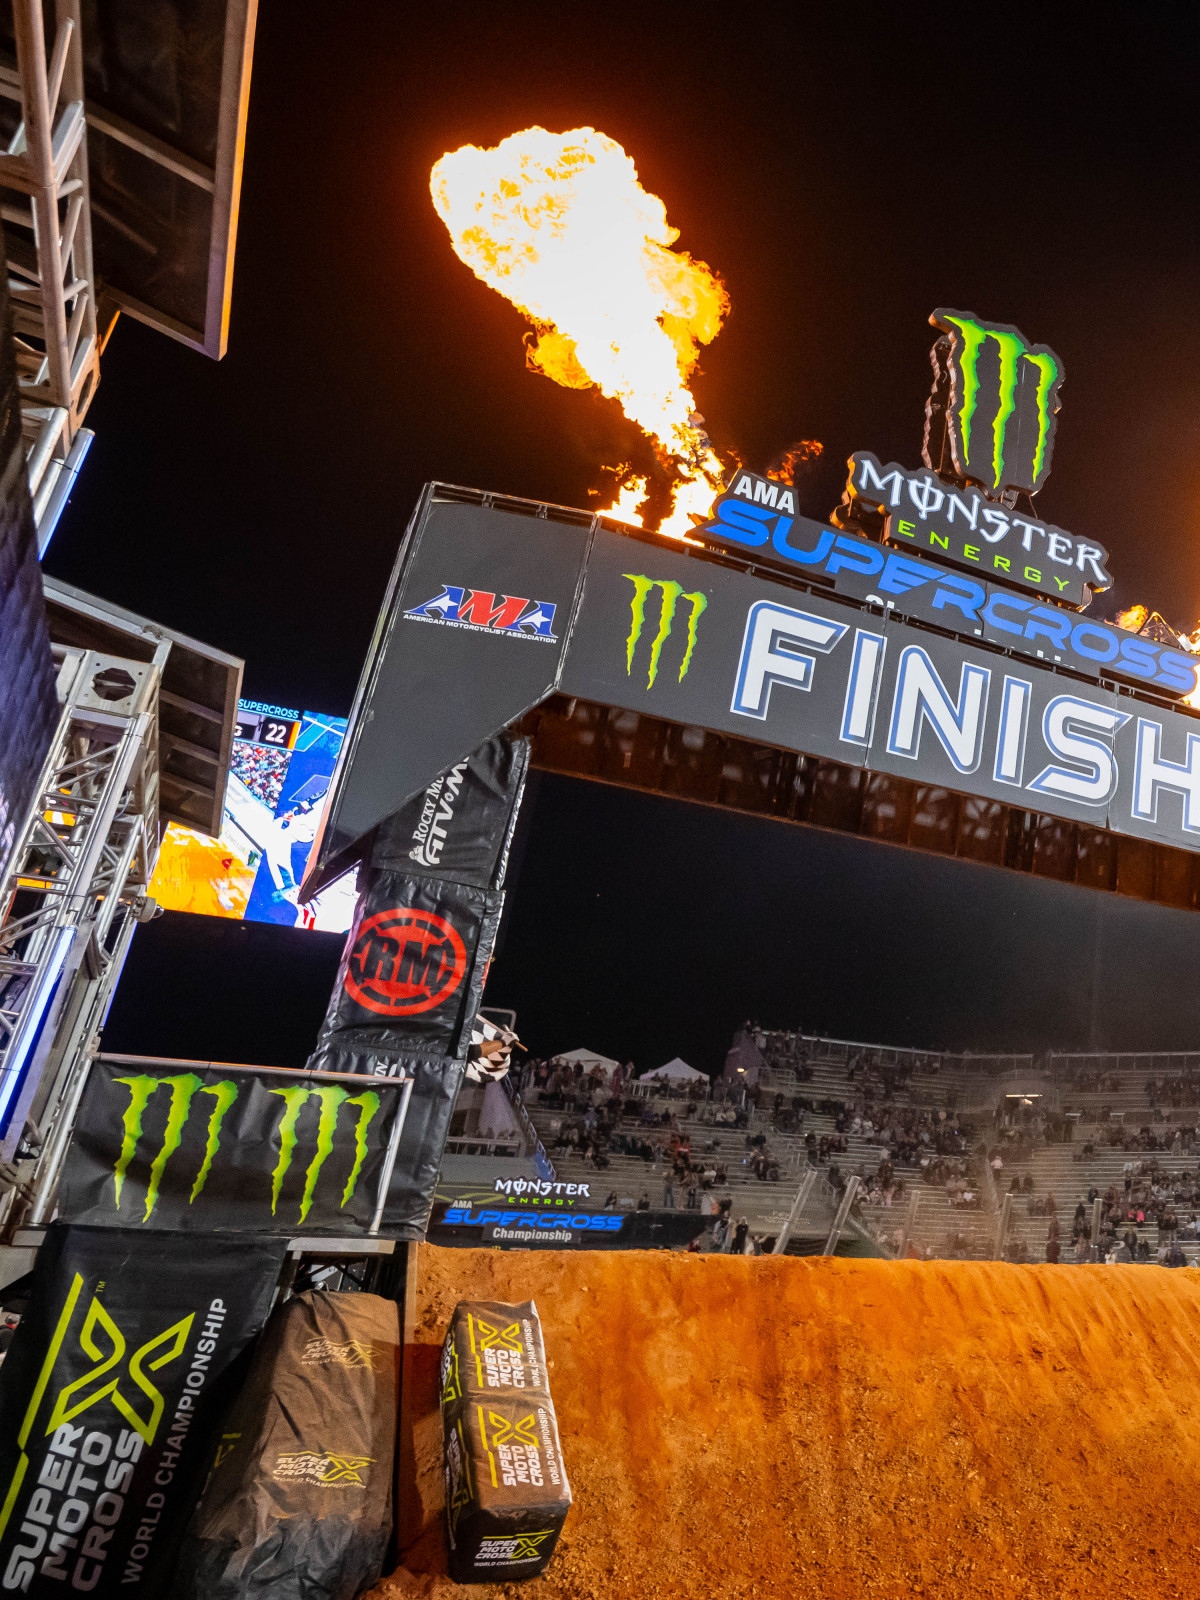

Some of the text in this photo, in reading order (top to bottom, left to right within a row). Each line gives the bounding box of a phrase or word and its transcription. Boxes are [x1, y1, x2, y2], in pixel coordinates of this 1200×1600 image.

[733, 474, 796, 514] AMA
[859, 459, 1108, 583] MONSTER
[898, 519, 1070, 592] ENERGY
[403, 584, 558, 638] AMA
[403, 613, 557, 644] AMERICAN MOTORCYCLIST ASSOCIATION
[238, 698, 300, 719] SUPERCROSS
[265, 723, 287, 743] 22
[412, 798, 437, 844] ROCKY
[452, 1200, 473, 1209] AMA
[494, 1178, 591, 1198] MONSTER
[508, 1197, 575, 1206] ENERGY
[442, 1209, 625, 1231] SUPERCROSS
[492, 1227, 573, 1242] Championship
[484, 1347, 500, 1388] SUPER
[496, 1349, 512, 1386] MOTO
[509, 1349, 526, 1389] CROSS
[530, 1364, 541, 1387] WORL
[121, 1297, 228, 1585] WORLD CHAMPIONSHIP
[538, 1408, 561, 1485] WORLD CHAMPIONSHIP
[497, 1443, 517, 1487] SUPER
[510, 1445, 531, 1484] MOTO
[524, 1444, 544, 1487] CROSS
[2, 1421, 85, 1594] SUPER
[40, 1430, 113, 1582] MOTO
[71, 1429, 144, 1592] CROSS
[474, 1552, 515, 1560] CROSS
